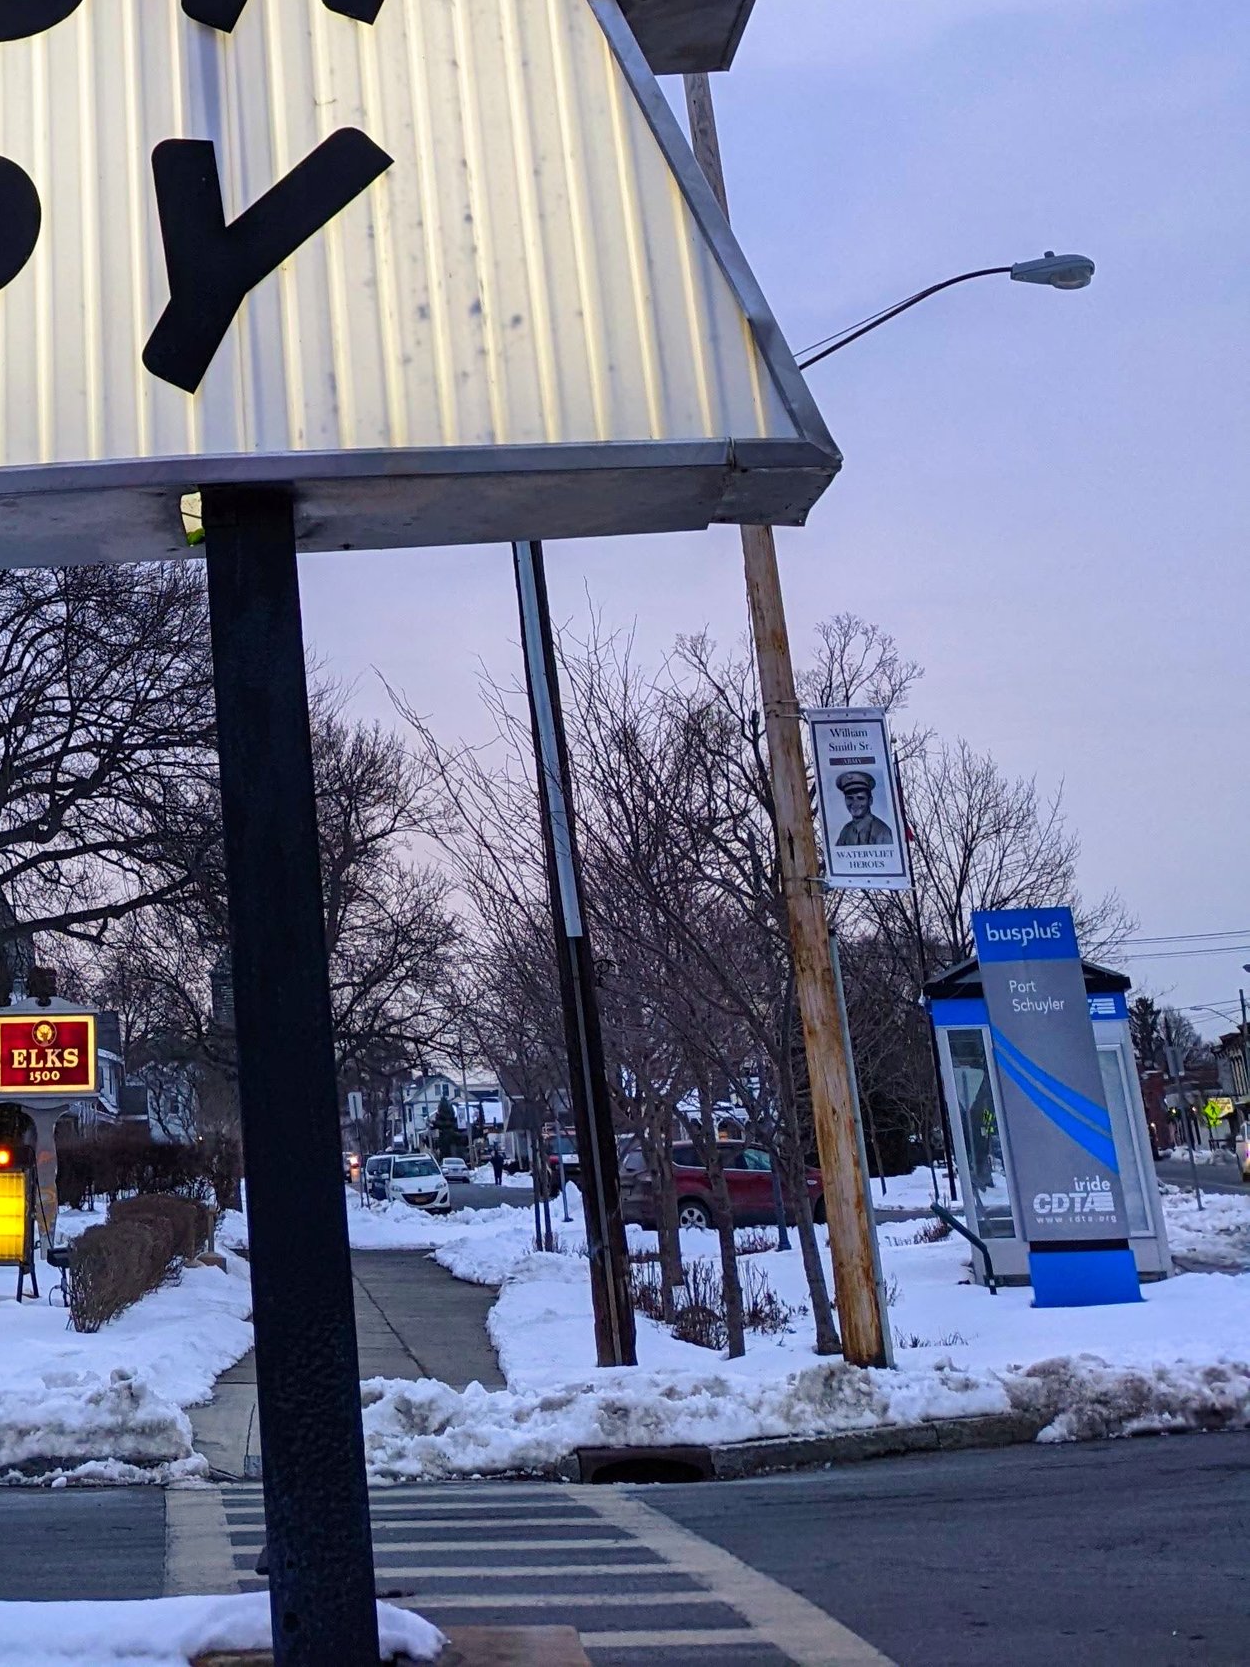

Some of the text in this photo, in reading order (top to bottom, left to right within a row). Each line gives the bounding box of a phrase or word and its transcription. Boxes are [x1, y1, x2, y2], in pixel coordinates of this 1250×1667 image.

[829, 727, 868, 738] William
[828, 741, 873, 752] Smith Sr.
[836, 849, 895, 859] WATERVLIET
[849, 860, 885, 869] HEROES
[985, 920, 1062, 947] busplus
[1008, 979, 1037, 993] Port
[1012, 996, 1065, 1015] Schuyler
[11, 1048, 79, 1069] ELKS
[29, 1070, 61, 1084] 1500
[1073, 1175, 1111, 1191] iride
[1032, 1192, 1115, 1214] CDTA
